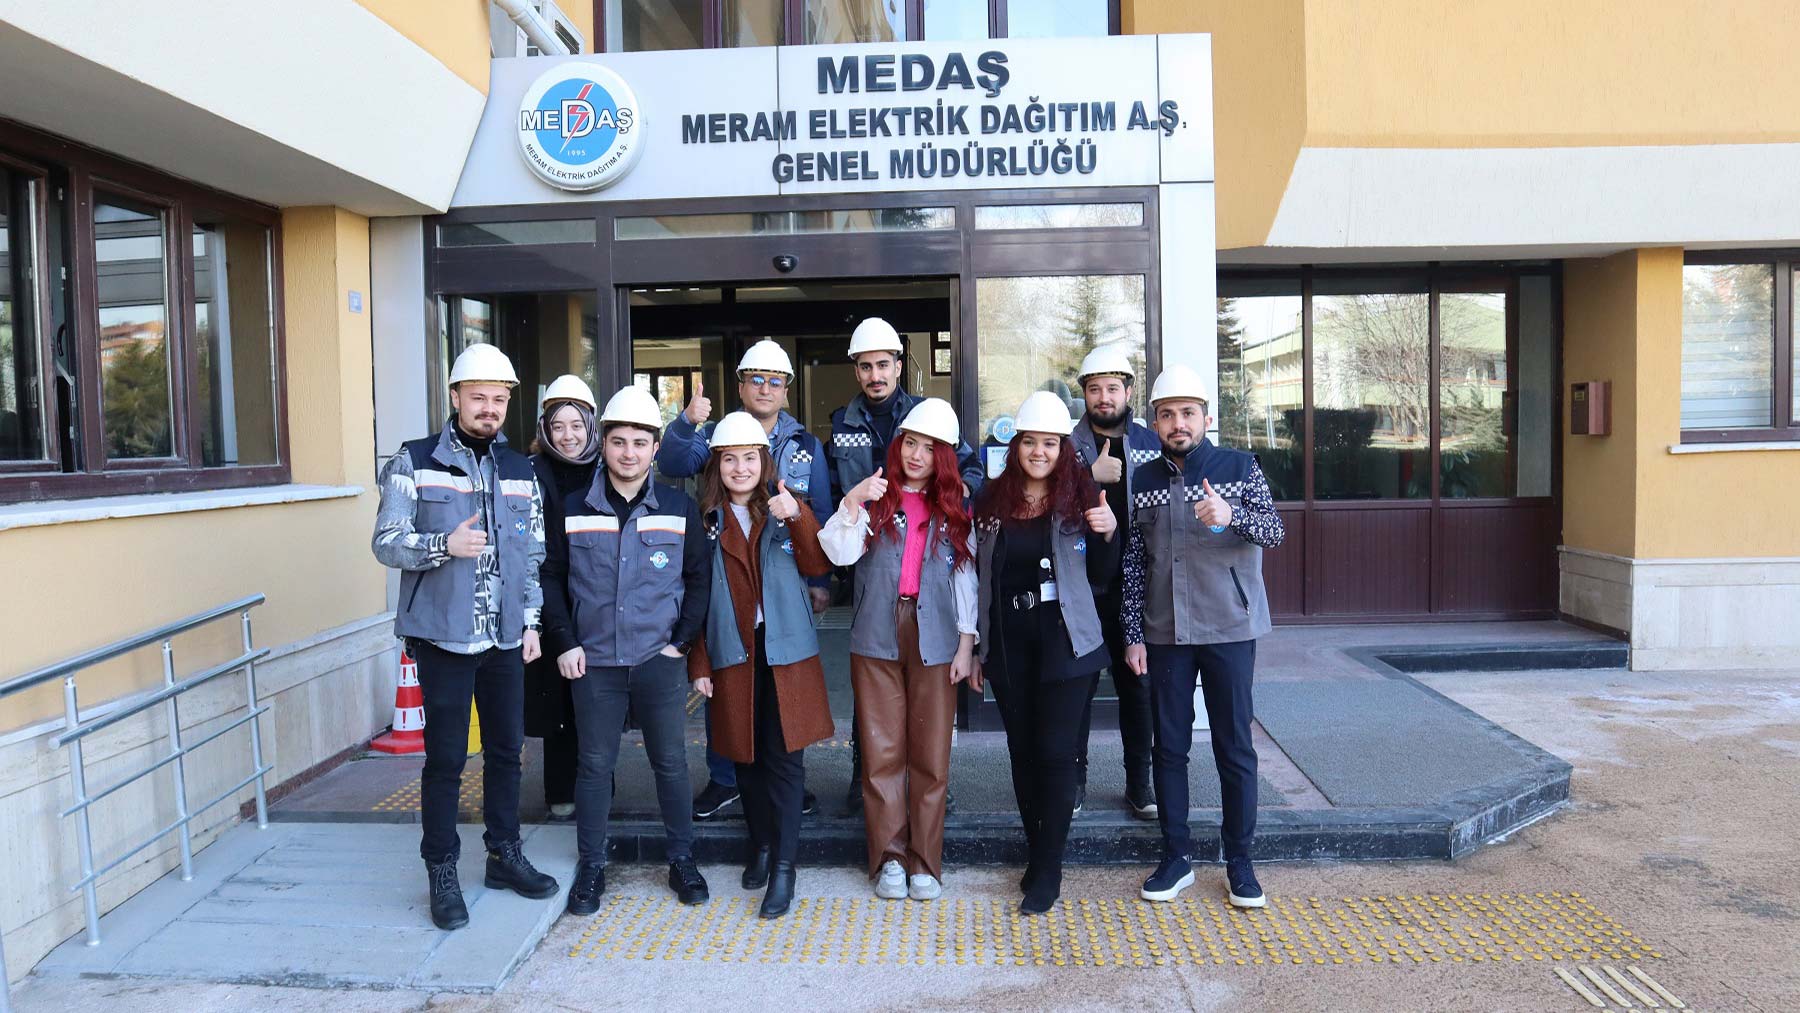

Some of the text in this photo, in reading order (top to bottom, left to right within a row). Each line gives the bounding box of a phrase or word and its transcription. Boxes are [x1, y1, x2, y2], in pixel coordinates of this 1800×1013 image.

[818, 51, 1010, 97] MEDAŞ
[521, 99, 633, 138] MEDAŞ
[682, 111, 796, 143] MERAM
[809, 98, 970, 138] ELEKTRİK
[981, 95, 1116, 134] DAĞITIM
[525, 143, 547, 169] MERAM
[548, 166, 586, 180] ELEKTRİK
[587, 156, 618, 179] DAĞITIM
[567, 149, 586, 157] 1995
[772, 138, 1097, 183] GENEL MÜDÜRLÜĞÜ
